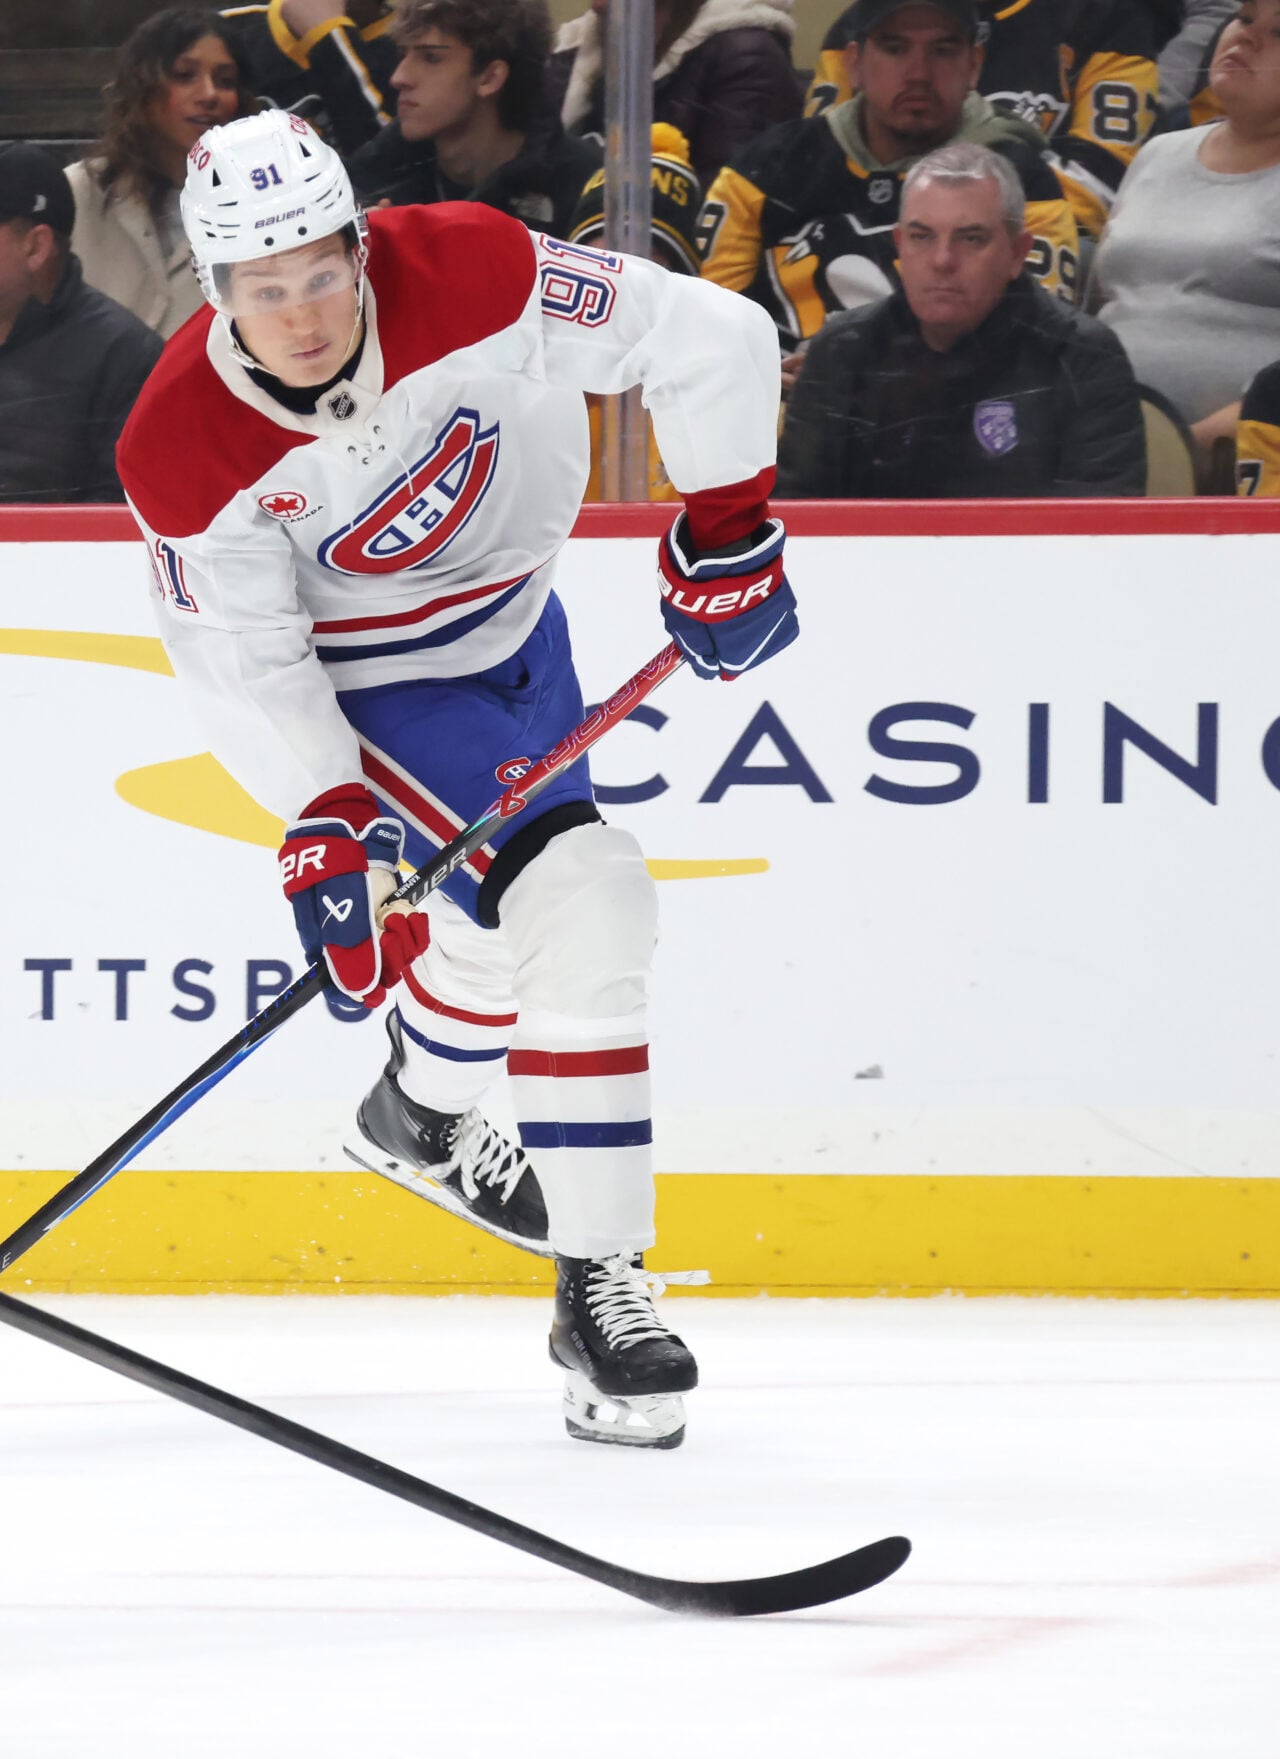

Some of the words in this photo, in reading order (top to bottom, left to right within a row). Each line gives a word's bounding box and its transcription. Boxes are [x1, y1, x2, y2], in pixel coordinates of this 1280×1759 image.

[250, 164, 283, 191] 91
[651, 167, 689, 206] NS
[254, 207, 306, 230] BAUER
[539, 232, 623, 328] 91
[282, 505, 324, 524] CANADA
[585, 700, 1280, 806] CASIN
[280, 844, 327, 882] ER
[412, 846, 467, 905] UER
